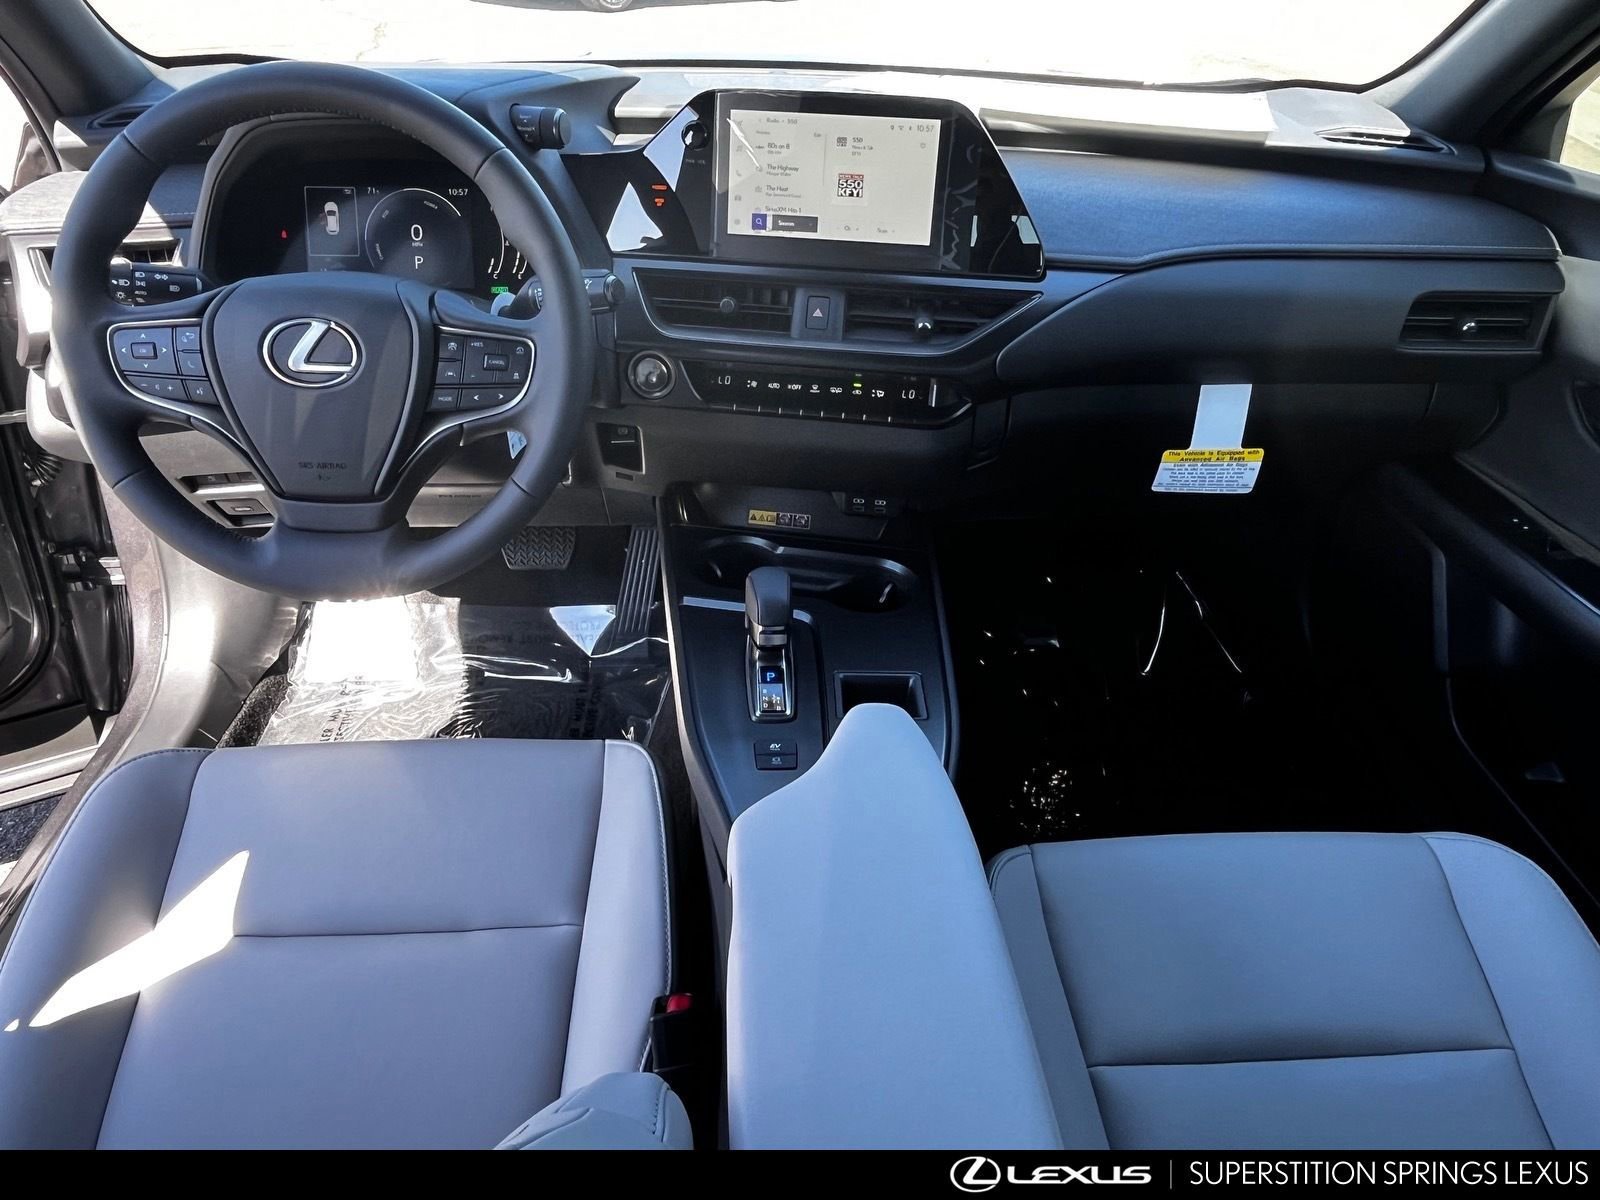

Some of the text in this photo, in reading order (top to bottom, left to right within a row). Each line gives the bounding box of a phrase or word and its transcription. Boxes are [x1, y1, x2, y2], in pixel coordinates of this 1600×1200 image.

[839, 180, 863, 189] 550
[839, 188, 863, 197] KFYI
[411, 224, 423, 241] 0
[414, 255, 424, 269] P
[718, 375, 731, 385] LO
[901, 389, 916, 400] LO
[766, 672, 776, 681] P
